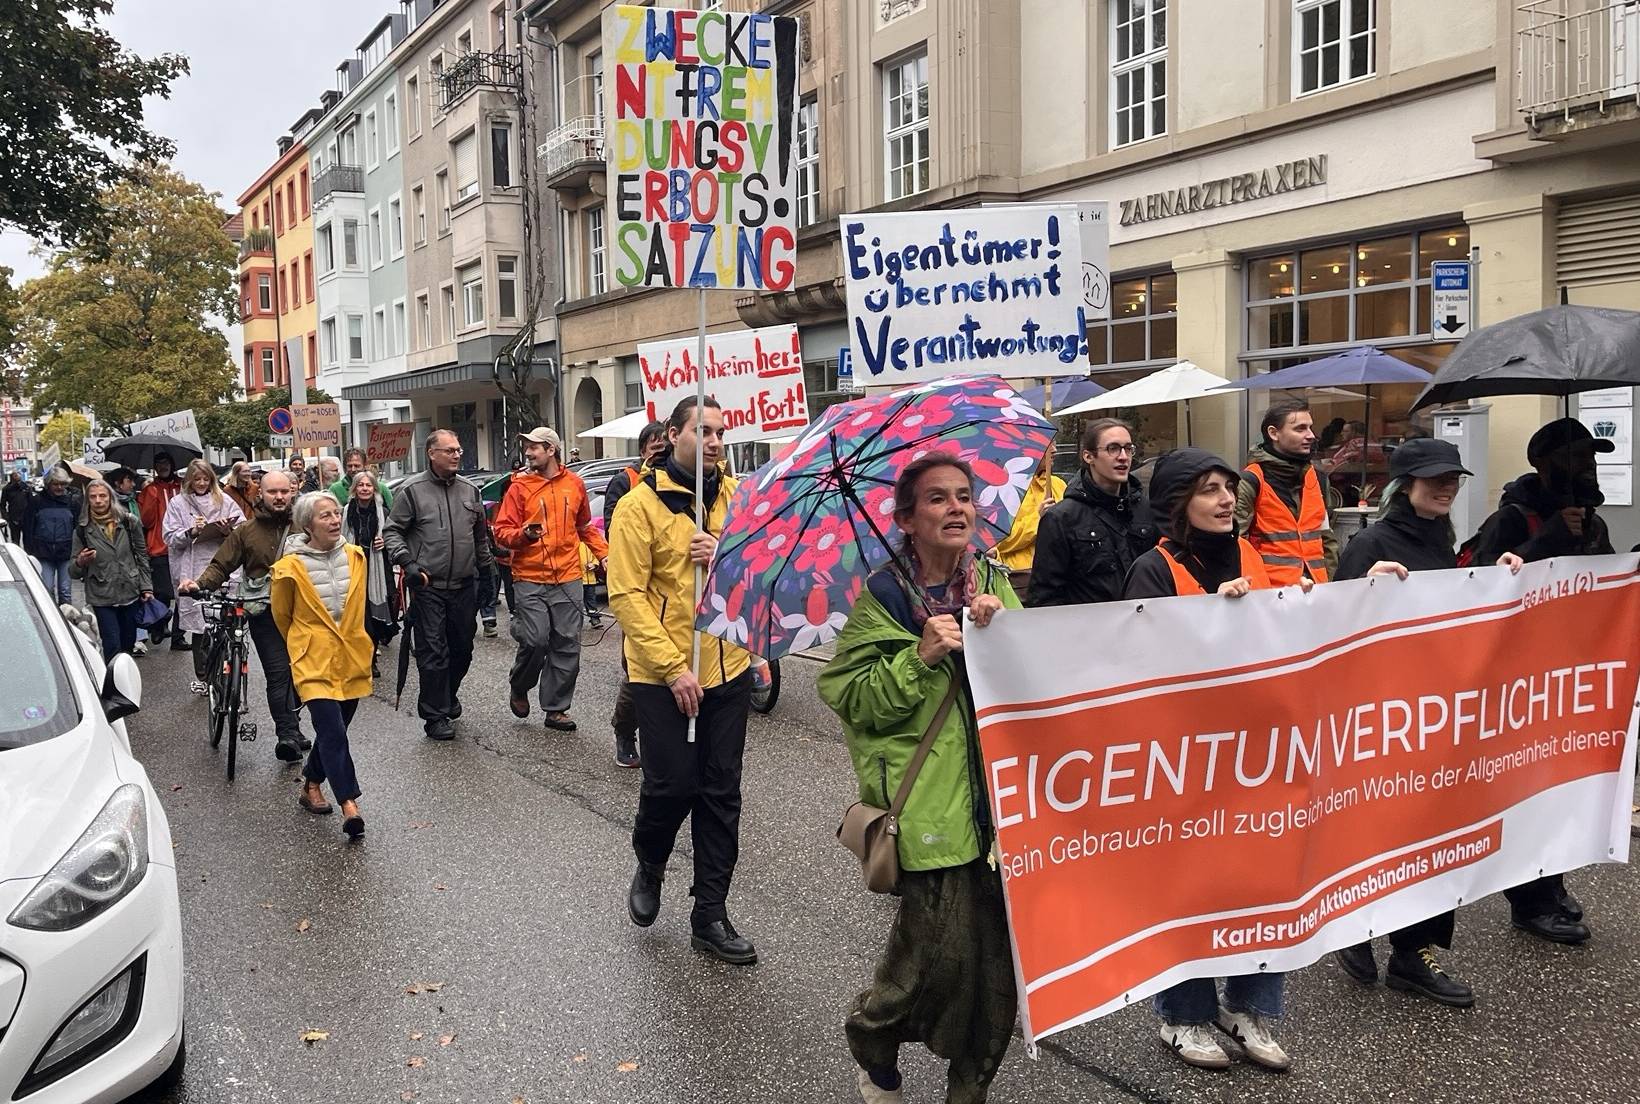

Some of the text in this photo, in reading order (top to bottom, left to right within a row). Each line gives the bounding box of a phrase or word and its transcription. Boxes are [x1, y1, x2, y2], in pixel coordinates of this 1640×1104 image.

[616, 7, 772, 69] ZWECKE
[616, 119, 773, 173] DUNGSV
[1119, 153, 1329, 226] ZAHNARZTPRAXEN
[616, 222, 795, 291] SATZUNG
[846, 215, 1061, 285] Eigentümer!
[864, 264, 1061, 313] übernehmt
[755, 331, 800, 371] her!
[855, 306, 1088, 376] Verantwortung!
[297, 427, 339, 445] Wohnung
[316, 408, 336, 416] ROSEN
[1557, 579, 1569, 598] 14
[1574, 571, 1593, 595] (2)
[991, 660, 1627, 829] EIGENTUM VERPFLICHTET
[1049, 816, 1172, 864] Gebrauch
[1180, 809, 1224, 840] soll
[1234, 798, 1323, 838] zugleich
[1324, 786, 1358, 812] dem
[1362, 768, 1425, 801] Wohle
[1431, 765, 1461, 789] der
[1465, 735, 1558, 783] Allgemeinheit
[1211, 835, 1490, 949] Karlsruher Aktionsbündnis Wohnen
